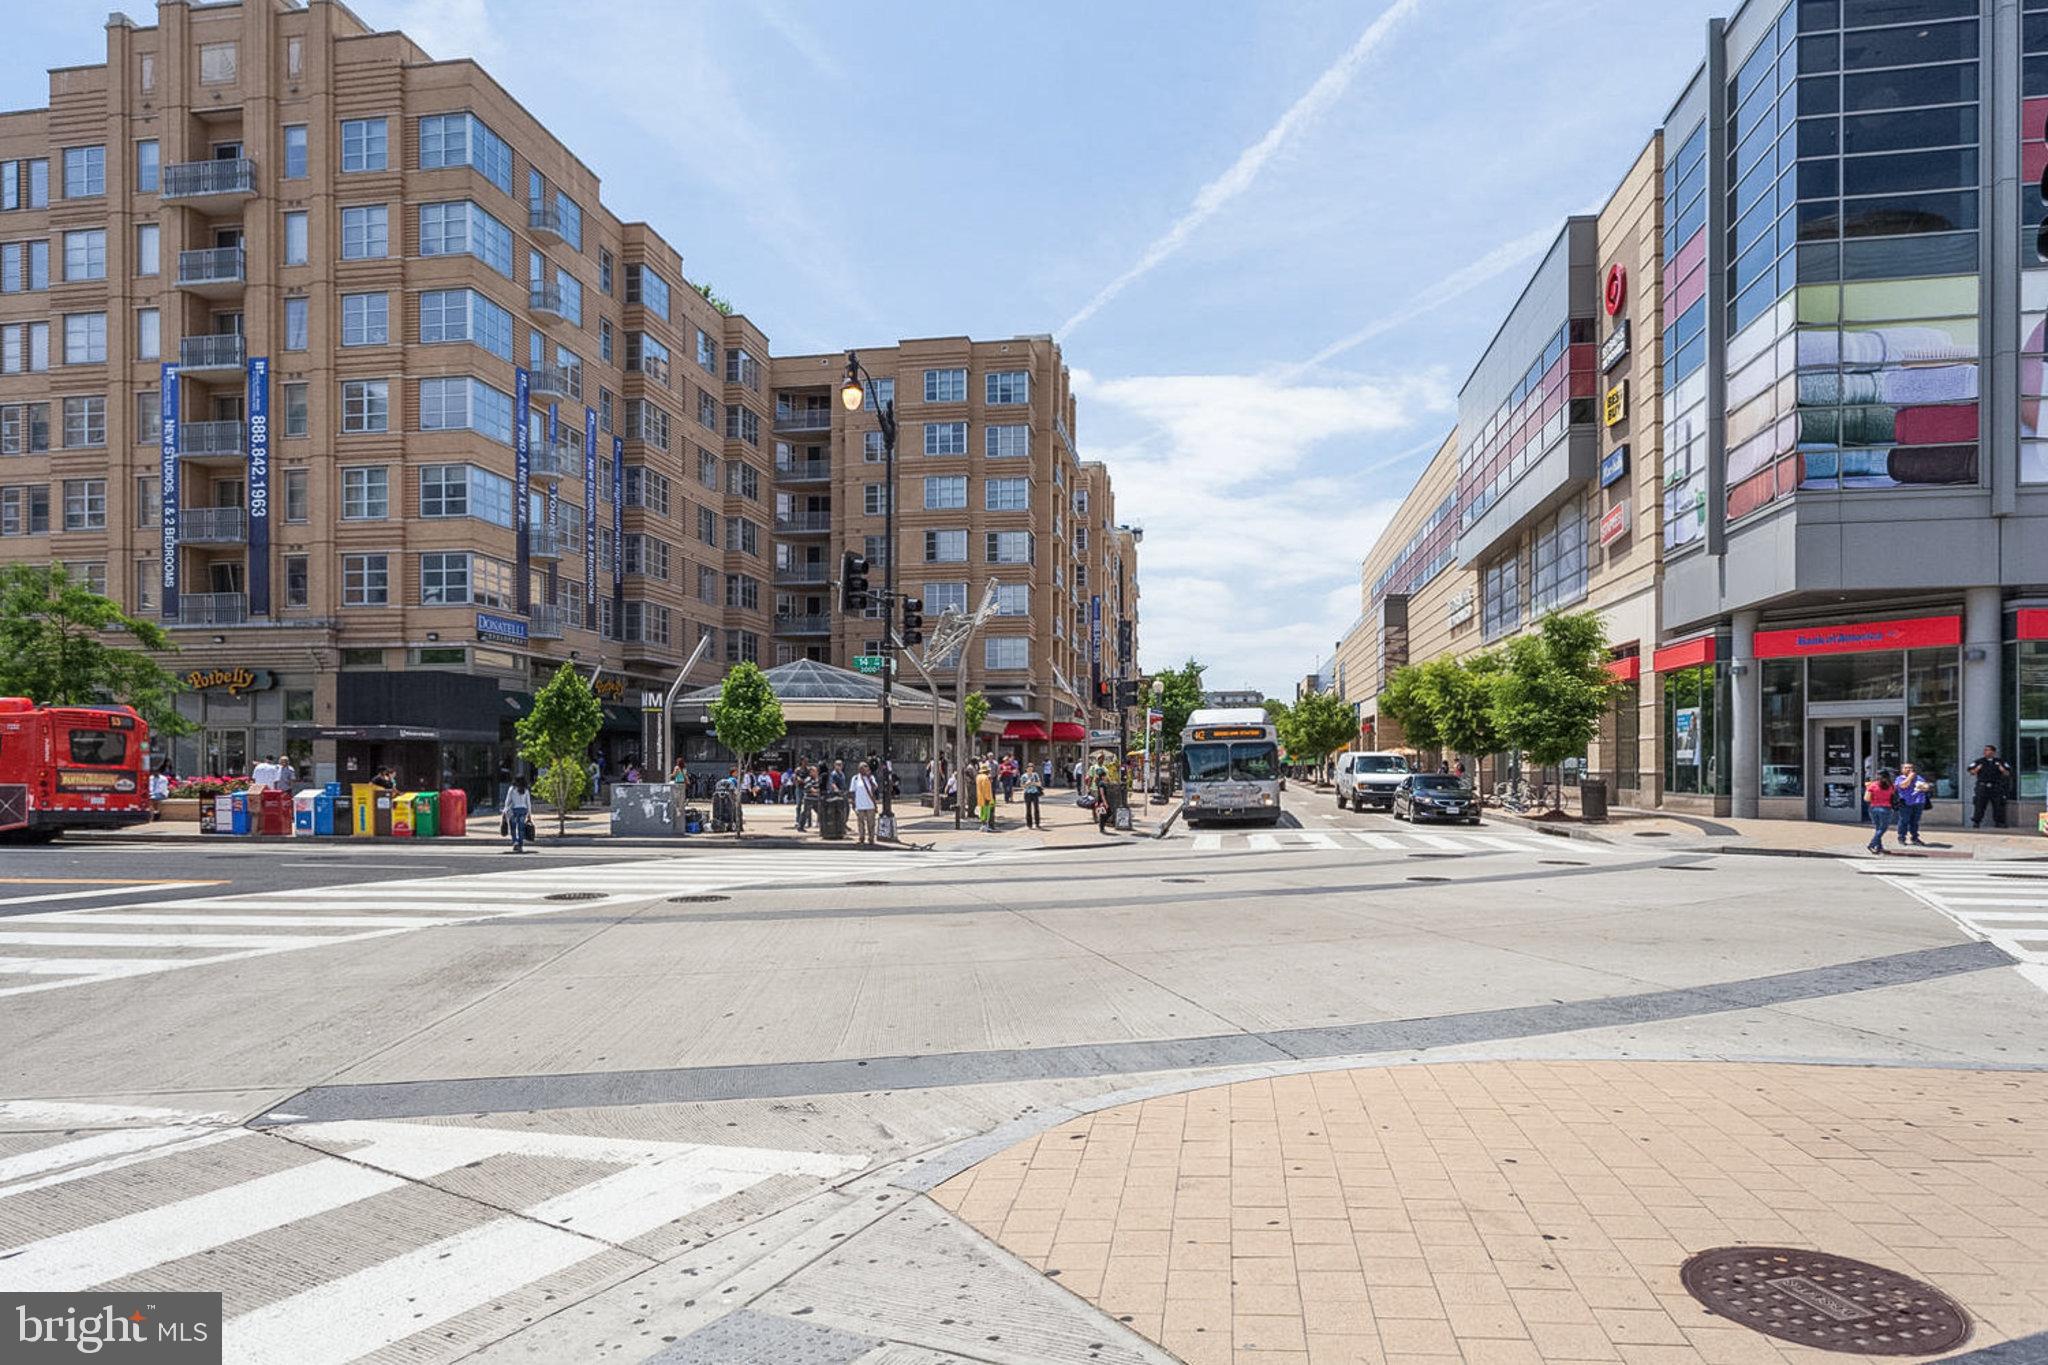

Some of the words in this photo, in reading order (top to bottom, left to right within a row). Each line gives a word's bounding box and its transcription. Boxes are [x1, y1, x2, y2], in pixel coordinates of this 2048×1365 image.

[163, 418, 176, 445] NEW
[518, 424, 528, 452] FIND
[163, 447, 176, 496] STUDIOS,
[250, 415, 267, 517] 888.842.1963
[518, 453, 528, 464] A
[518, 466, 528, 494] NEW
[164, 507, 176, 516] &
[164, 518, 176, 526] 2
[163, 527, 176, 588] BEDROOMS
[478, 614, 525, 636] DONATELLI
[1797, 636, 1825, 646] Bank
[187, 666, 255, 695] Potbelly
